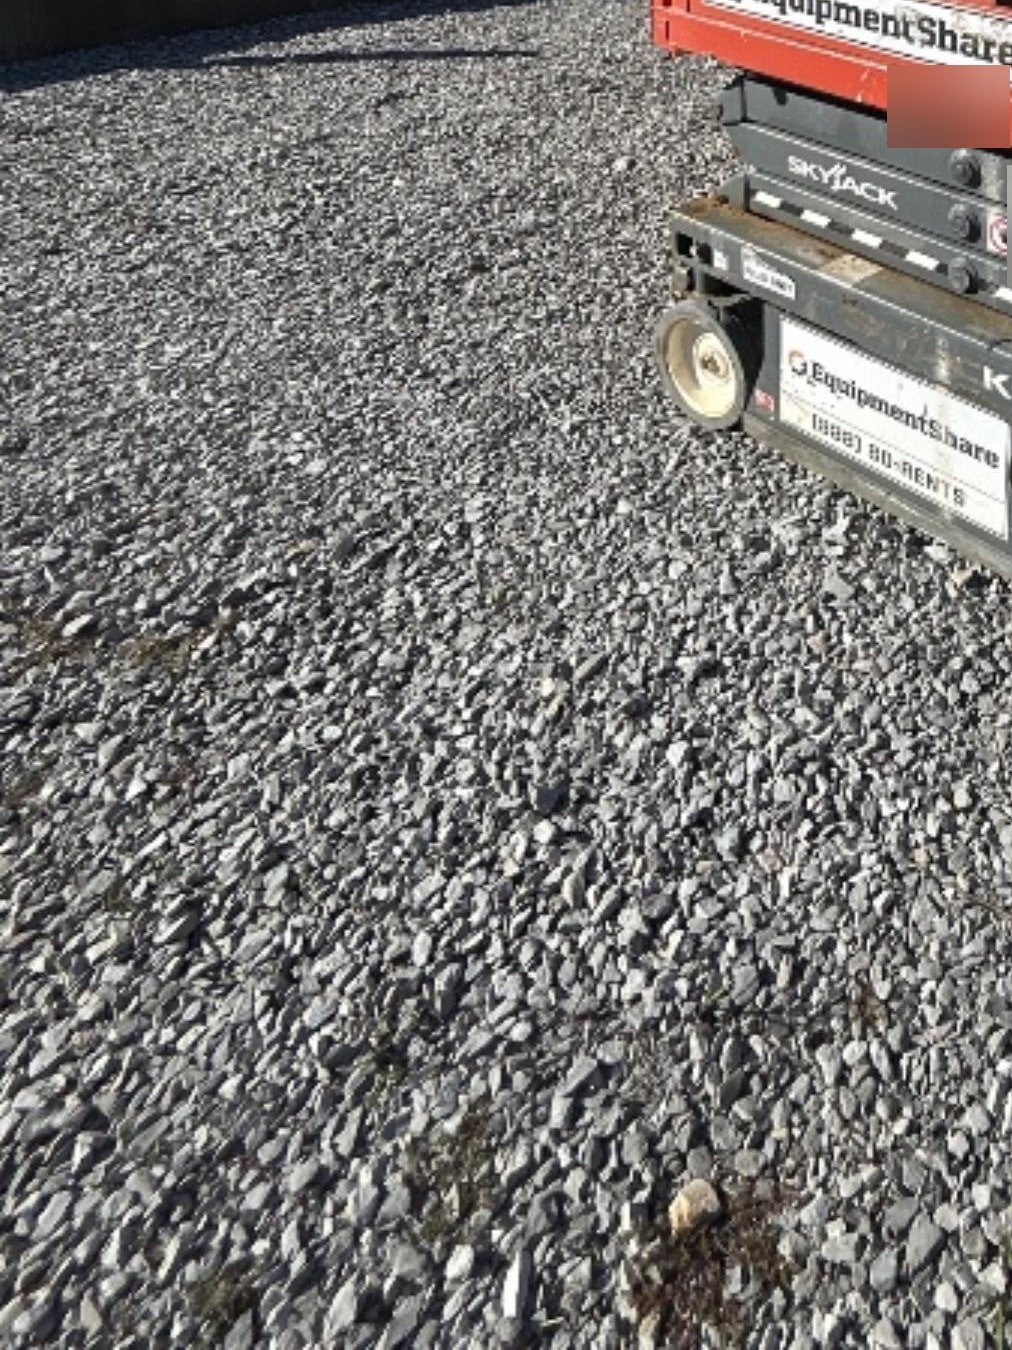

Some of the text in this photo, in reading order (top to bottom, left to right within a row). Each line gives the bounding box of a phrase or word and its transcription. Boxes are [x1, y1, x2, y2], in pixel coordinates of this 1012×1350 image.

[788, 155, 898, 210] SKYJACK
[983, 365, 1012, 400] K
[812, 361, 1000, 469] EquipmentShare
